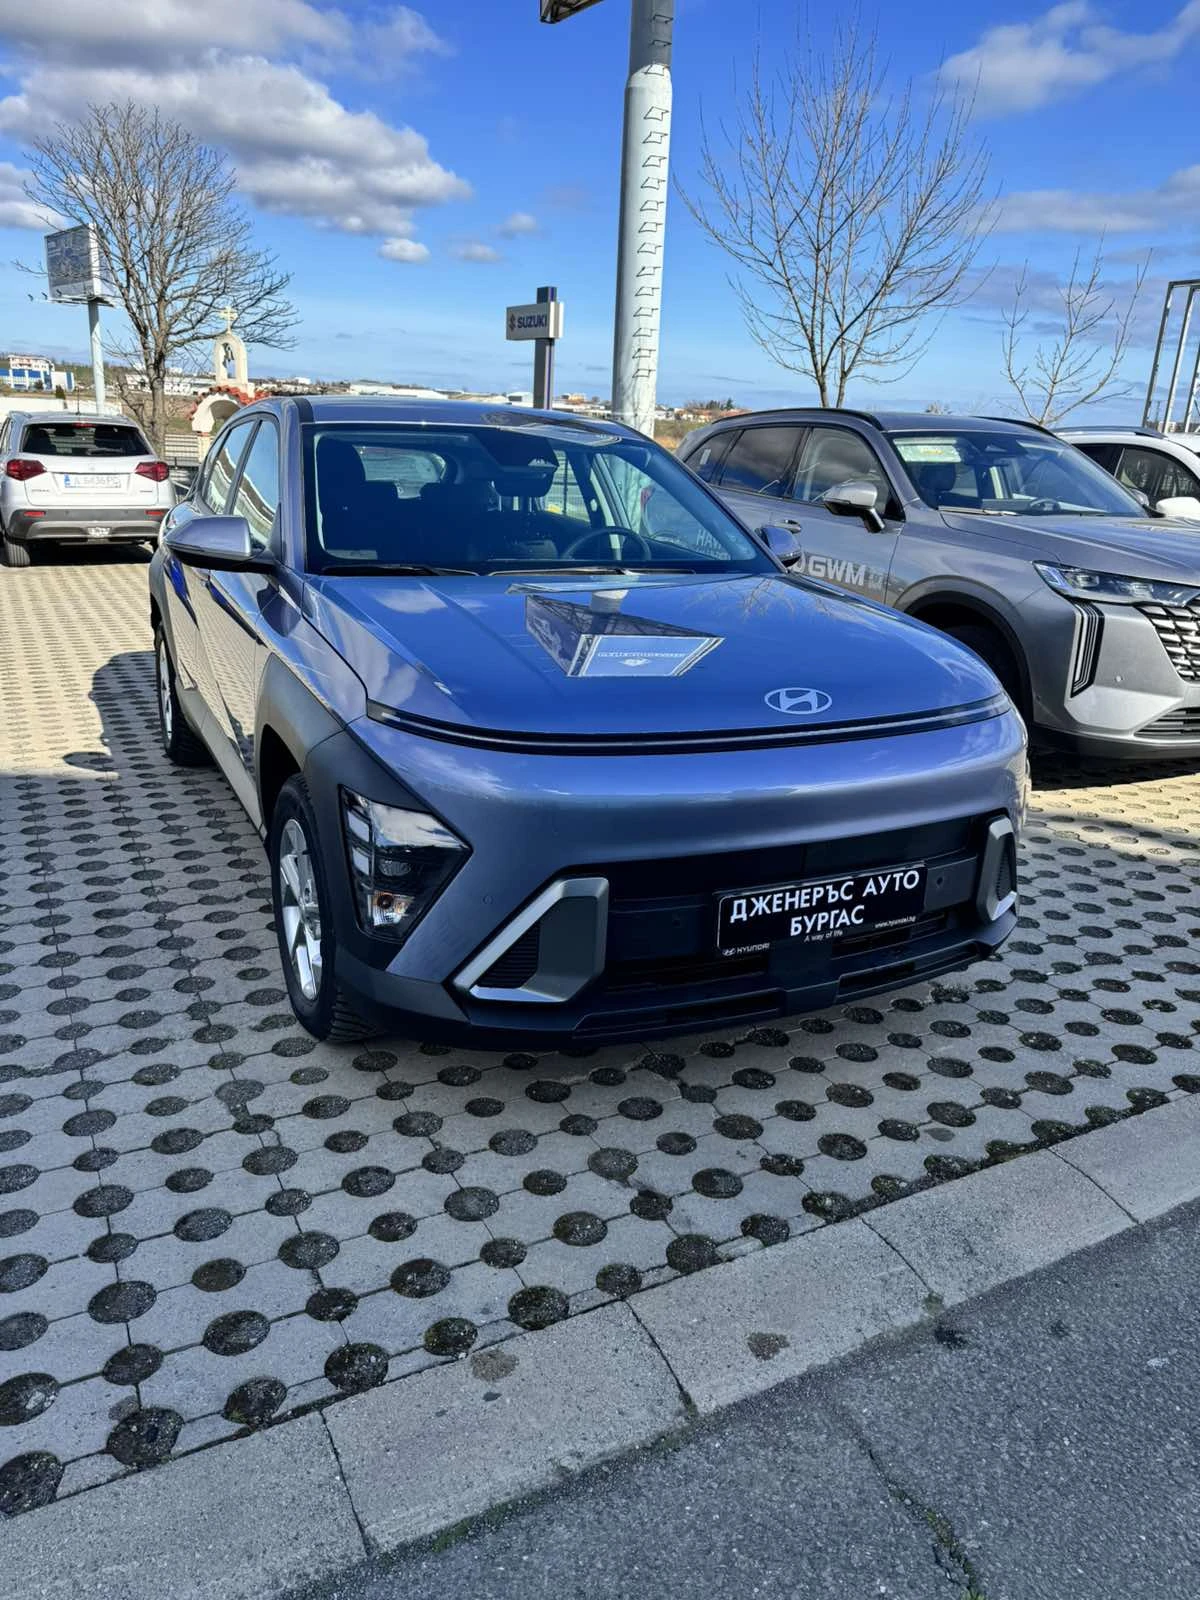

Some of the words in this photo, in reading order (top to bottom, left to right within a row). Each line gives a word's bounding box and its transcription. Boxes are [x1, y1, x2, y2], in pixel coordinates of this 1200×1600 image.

[517, 314, 548, 328] SUZUKI
[808, 555, 867, 586] GWM
[729, 880, 855, 923] ДЖЕНЕРЪС
[862, 870, 920, 897] АУТО
[790, 905, 865, 936] БУРГАС
[803, 935, 810, 943] A
[825, 930, 833, 938] of
[833, 929, 843, 937] life
[736, 942, 771, 954] HYUNDAI
